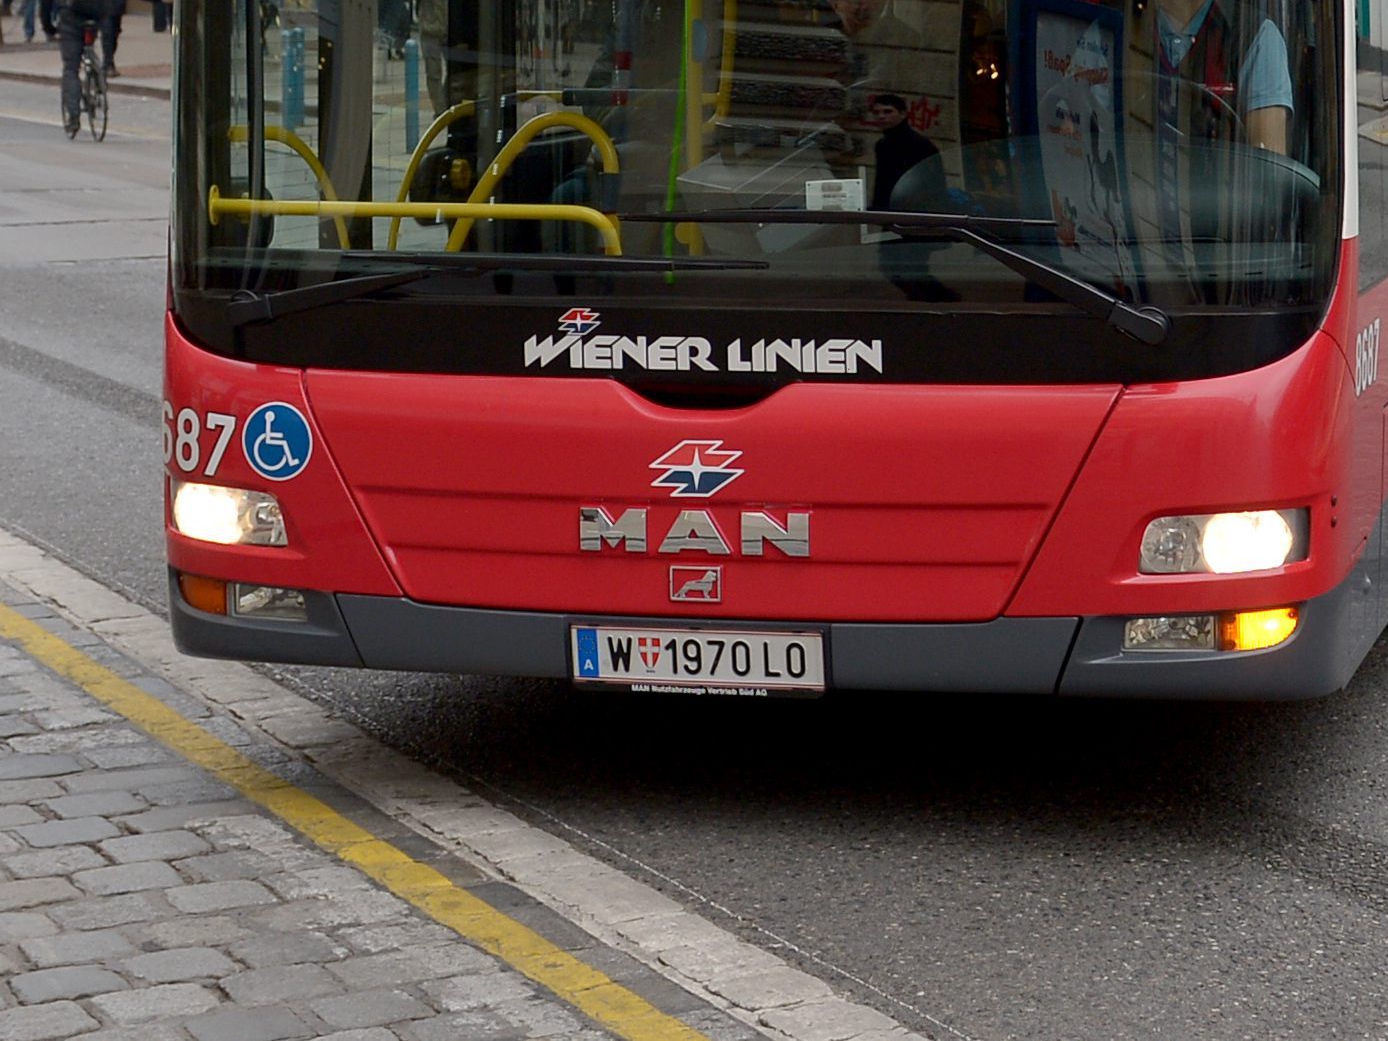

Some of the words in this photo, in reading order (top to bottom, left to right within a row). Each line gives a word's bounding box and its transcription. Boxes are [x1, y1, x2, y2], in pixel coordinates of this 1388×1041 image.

[523, 335, 719, 373] WIENER
[727, 337, 883, 374] LINIEN
[1357, 320, 1381, 396] 8687
[579, 506, 811, 558] MAN
[607, 636, 633, 673] W
